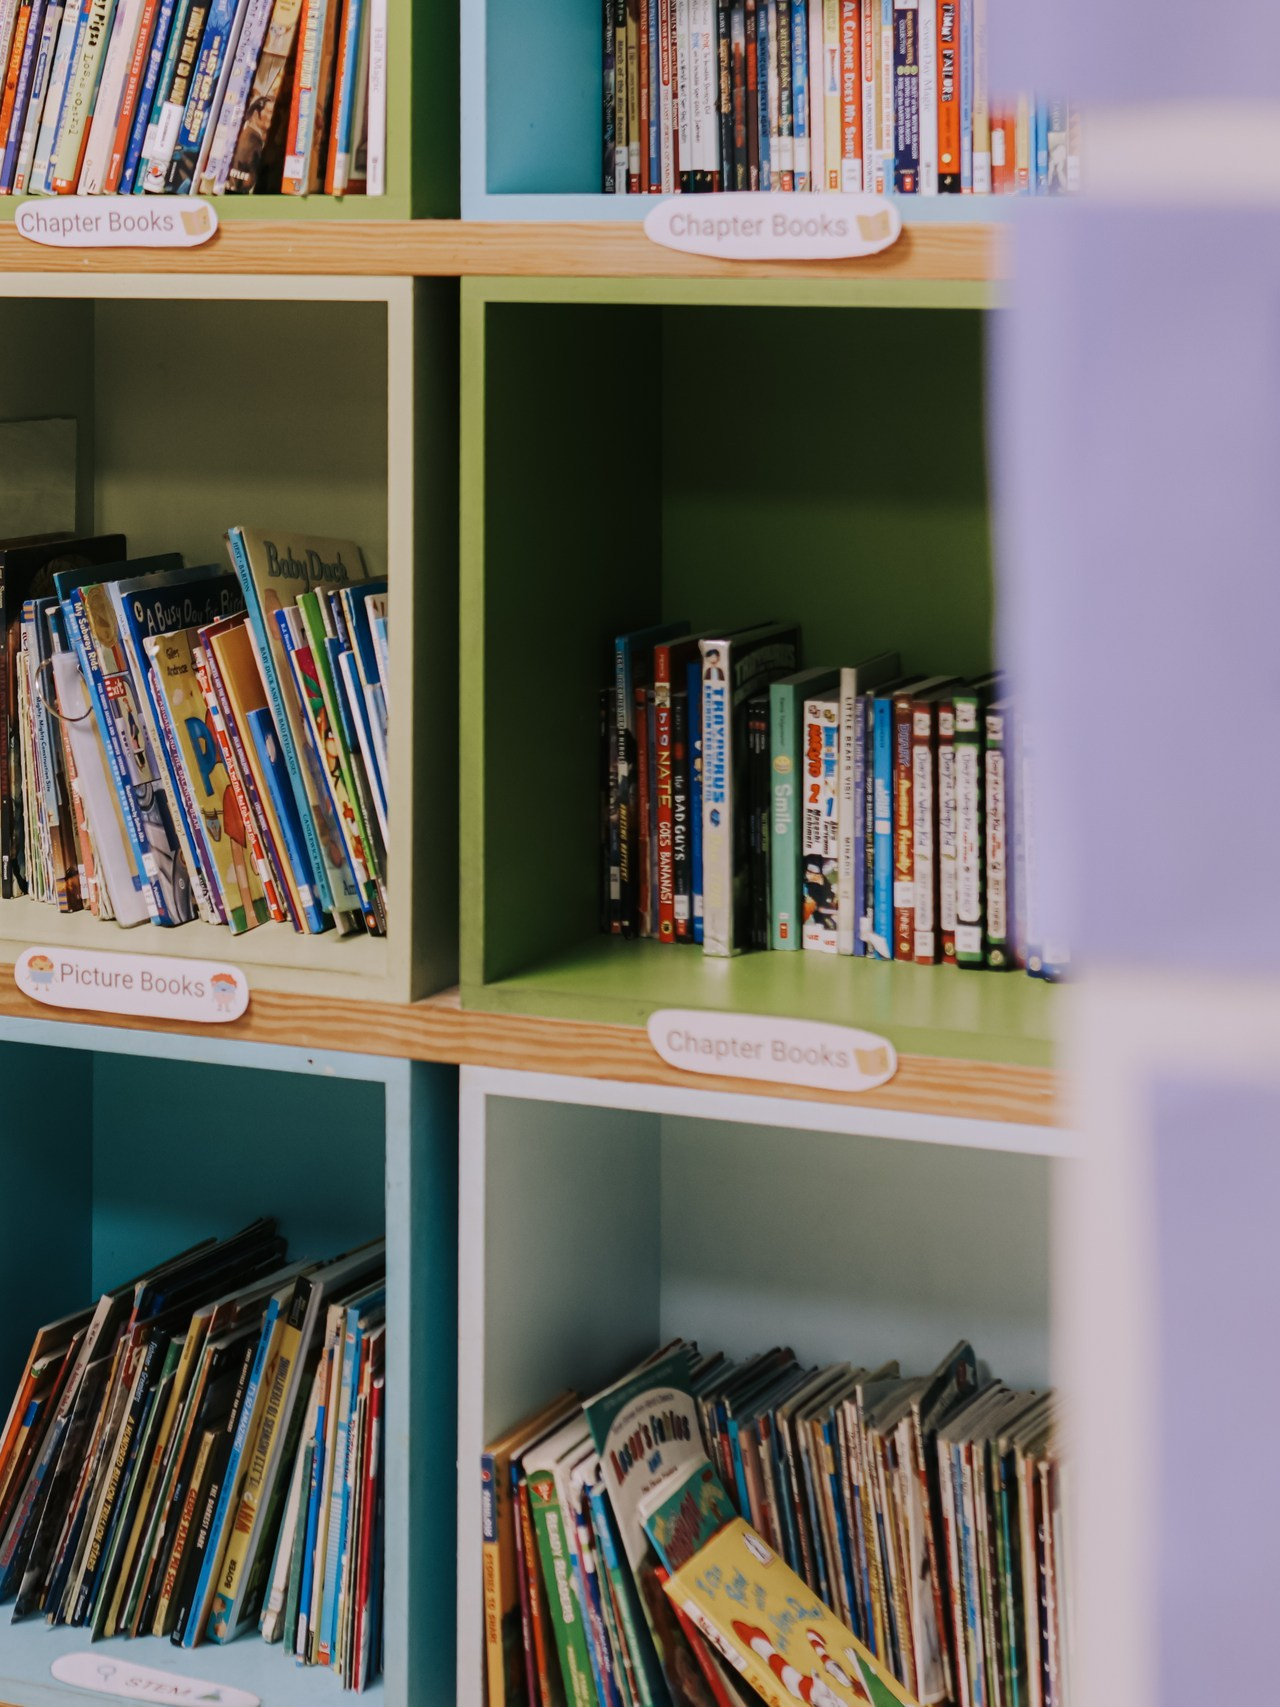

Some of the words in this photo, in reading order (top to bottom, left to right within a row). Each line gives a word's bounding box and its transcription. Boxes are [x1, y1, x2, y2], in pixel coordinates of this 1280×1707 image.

[143, 7, 152, 24] THE
[132, 28, 148, 73] HUNDRED
[844, 21, 855, 69] CAPONE
[205, 49, 218, 75] LAST
[618, 68, 623, 77] of
[941, 49, 954, 102] FAILURE
[122, 77, 137, 116] DRESSES
[199, 76, 212, 100] KIDS
[844, 73, 855, 102] DOES
[188, 110, 203, 142] EARTH
[21, 212, 100, 236] Chapter
[109, 211, 173, 232] Books
[670, 214, 763, 241] Chapter
[772, 214, 848, 237] Books
[232, 542, 243, 559] HEST
[237, 564, 251, 592] BARTON
[73, 602, 85, 615] My
[77, 618, 93, 650] Subway
[84, 651, 98, 671] Ride
[259, 646, 270, 664] BABY
[264, 666, 275, 684] DUCK
[270, 687, 280, 702] AND
[274, 703, 283, 716] THE
[36, 696, 44, 719] Mighty,
[41, 742, 51, 779] Construction
[277, 717, 287, 732] BAD
[281, 733, 298, 775] EYEGLASSES
[807, 724, 822, 777] NARUTO
[658, 750, 671, 809] NATE
[674, 775, 684, 789] the
[809, 784, 820, 804] 2
[674, 795, 684, 821] BAD
[774, 784, 792, 835] Smile
[659, 822, 670, 847] GOES
[674, 825, 685, 861] GUYS
[659, 851, 671, 904] BANANAS!
[60, 963, 133, 990] Picture
[140, 972, 205, 998] Books
[666, 1029, 763, 1062] Chapter
[772, 1040, 849, 1069] Books
[266, 1359, 291, 1404] EVERYTHING
[263, 1407, 278, 1417] TO
[114, 1425, 133, 1466] HUNDRED
[253, 1420, 275, 1455] ANSWERS
[104, 1468, 121, 1502] BILLION
[209, 1484, 220, 1497] THE
[93, 1503, 111, 1542] TRILLION
[200, 1498, 216, 1530] DARKEST
[233, 1491, 257, 1535] WHY?
[195, 1531, 207, 1549] DARK
[84, 1542, 100, 1572] STARS
[224, 1559, 238, 1589] BOYER
[125, 1678, 194, 1697] STEM
